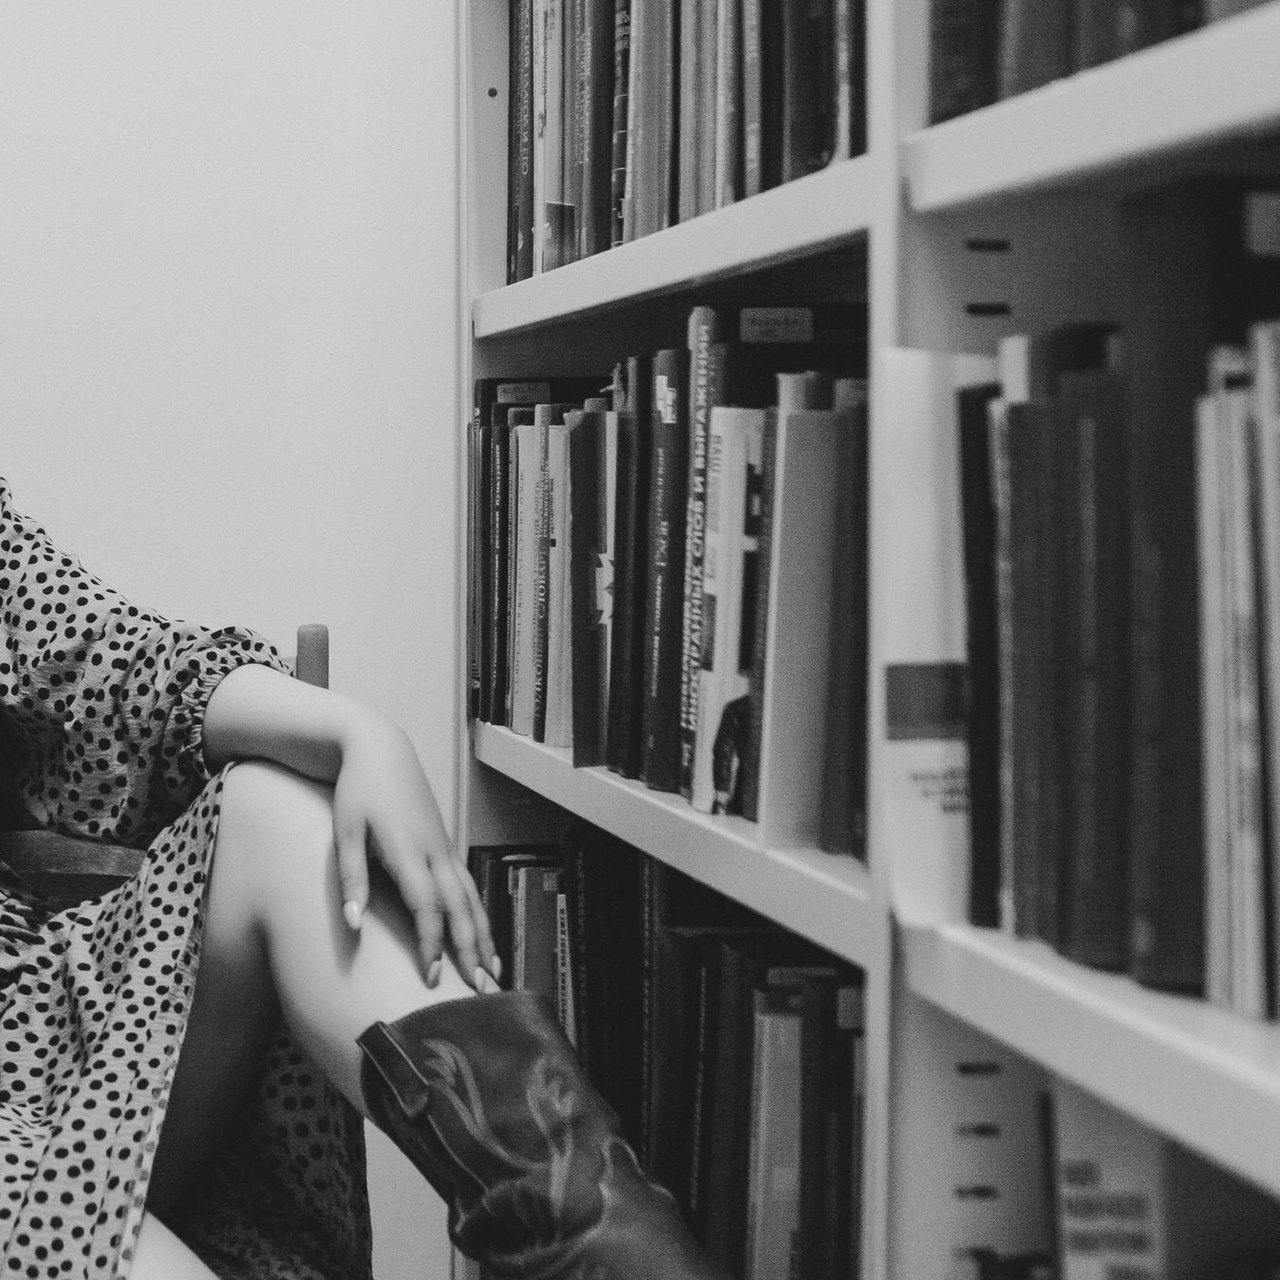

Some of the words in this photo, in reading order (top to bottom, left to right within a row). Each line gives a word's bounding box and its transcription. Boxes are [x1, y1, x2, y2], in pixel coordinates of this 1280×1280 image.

[695, 475, 705, 493] И
[693, 500, 705, 558] СЛОВ
[538, 547, 548, 620] СЛОВАРЬ
[688, 564, 703, 731] ИНОСТРАННЫХ
